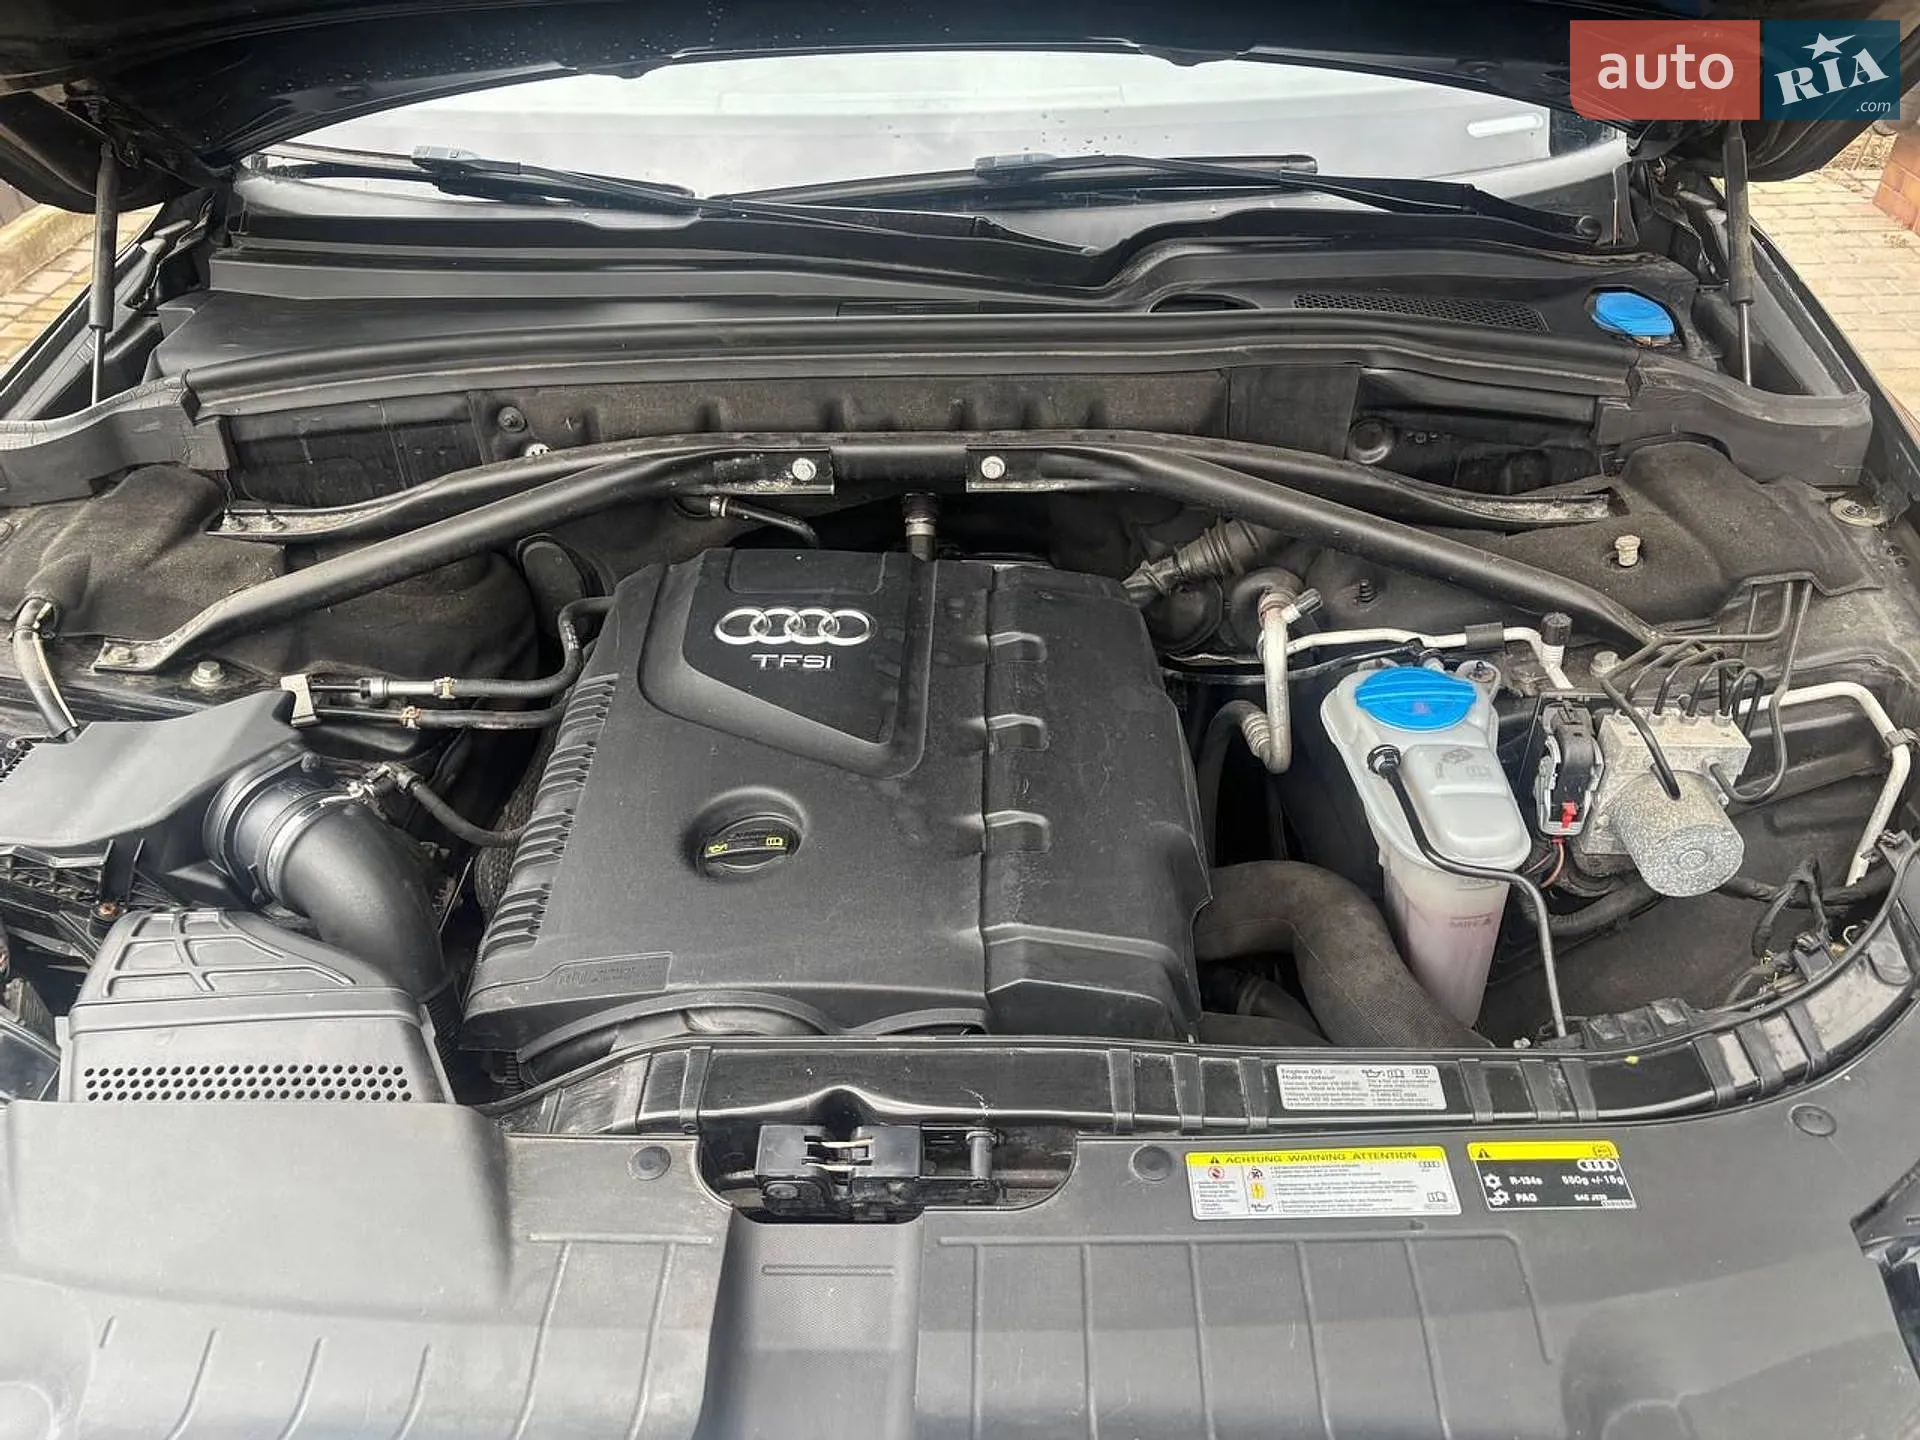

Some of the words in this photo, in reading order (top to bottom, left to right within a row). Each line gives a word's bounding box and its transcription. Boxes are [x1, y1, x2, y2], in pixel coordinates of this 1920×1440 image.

[751, 654, 831, 669] TFSI
[1225, 1155, 1282, 1164] ACHTUNG
[1286, 1153, 1346, 1162] WARNING
[1352, 1151, 1418, 1160] ATTENTION
[1515, 1192, 1538, 1202] PAG
